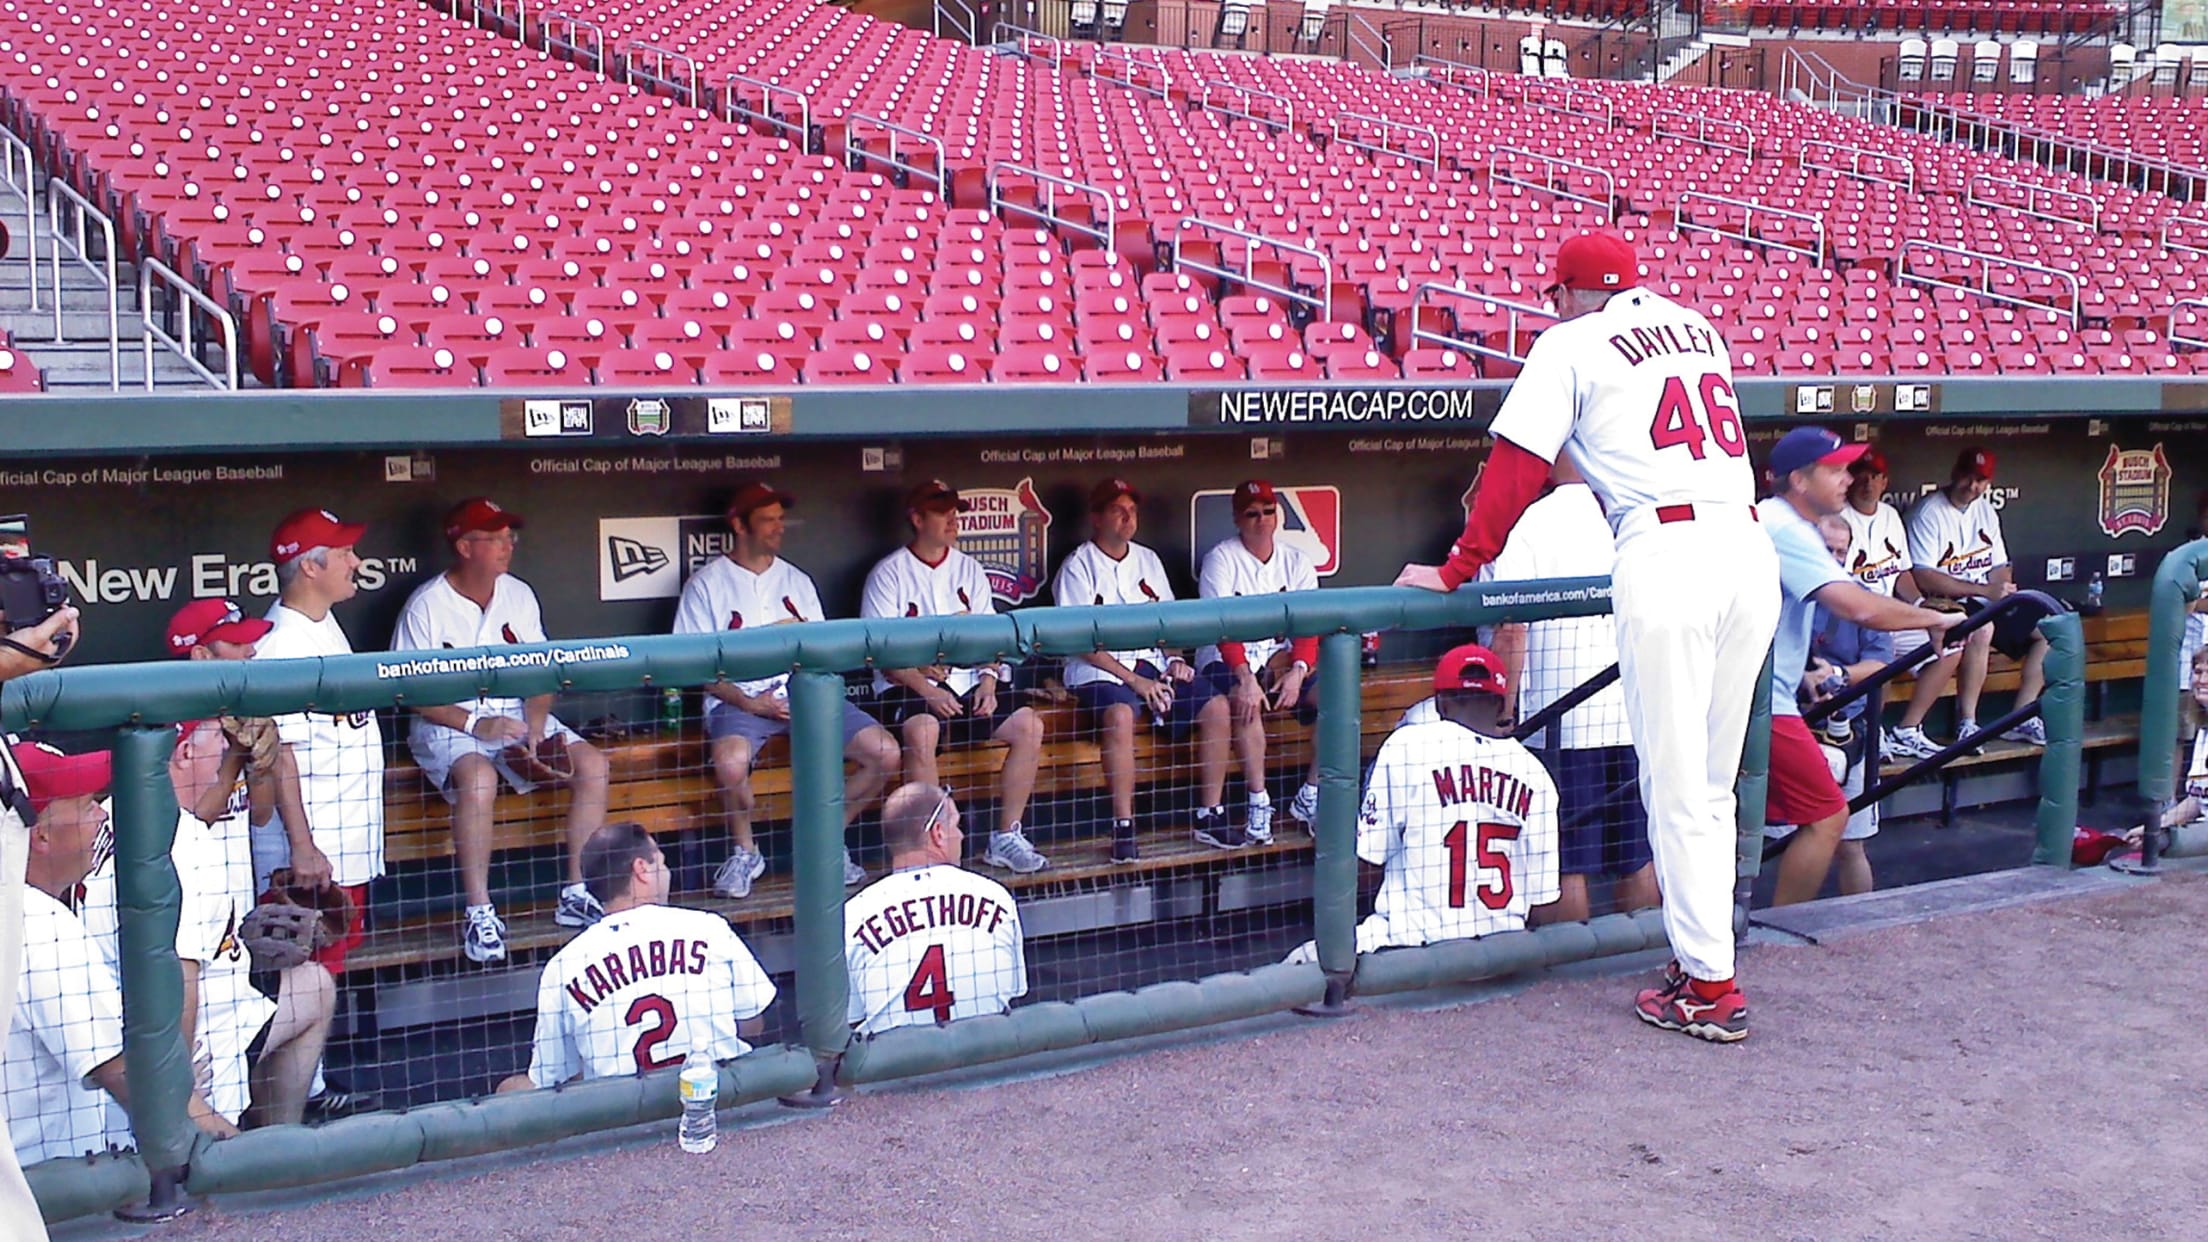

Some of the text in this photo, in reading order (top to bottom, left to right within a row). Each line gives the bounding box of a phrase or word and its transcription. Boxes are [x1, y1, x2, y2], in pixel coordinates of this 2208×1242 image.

[1609, 323, 1716, 367] DAYLEY
[1221, 390, 1473, 422] NEWERACAP.COM
[1649, 372, 1746, 461] 46
[531, 455, 781, 474] Official Cap of Major League Baseball
[981, 445, 1185, 463] Official Cap of Major League Baseball
[1348, 438, 1382, 451] Official
[1384, 438, 1404, 452] Cap
[1406, 437, 1415, 449] of
[1418, 437, 1444, 451] Major
[43, 469, 76, 488] Cap
[81, 469, 98, 484] of
[103, 468, 149, 486] Major
[154, 467, 212, 484] League
[216, 465, 283, 480] Baseball
[957, 513, 1016, 532] TADIUM
[965, 496, 1008, 512] USCH
[58, 558, 178, 604] New
[192, 552, 279, 598] Era
[377, 644, 630, 679] bankofamerica.com/Cardinals
[1432, 764, 1534, 821] MARTIN
[1443, 819, 1522, 910] 15
[853, 893, 1009, 956] TEGETHOFF
[565, 938, 709, 1014] KARABAS
[903, 944, 956, 1022] 4
[624, 993, 688, 1072] 2
